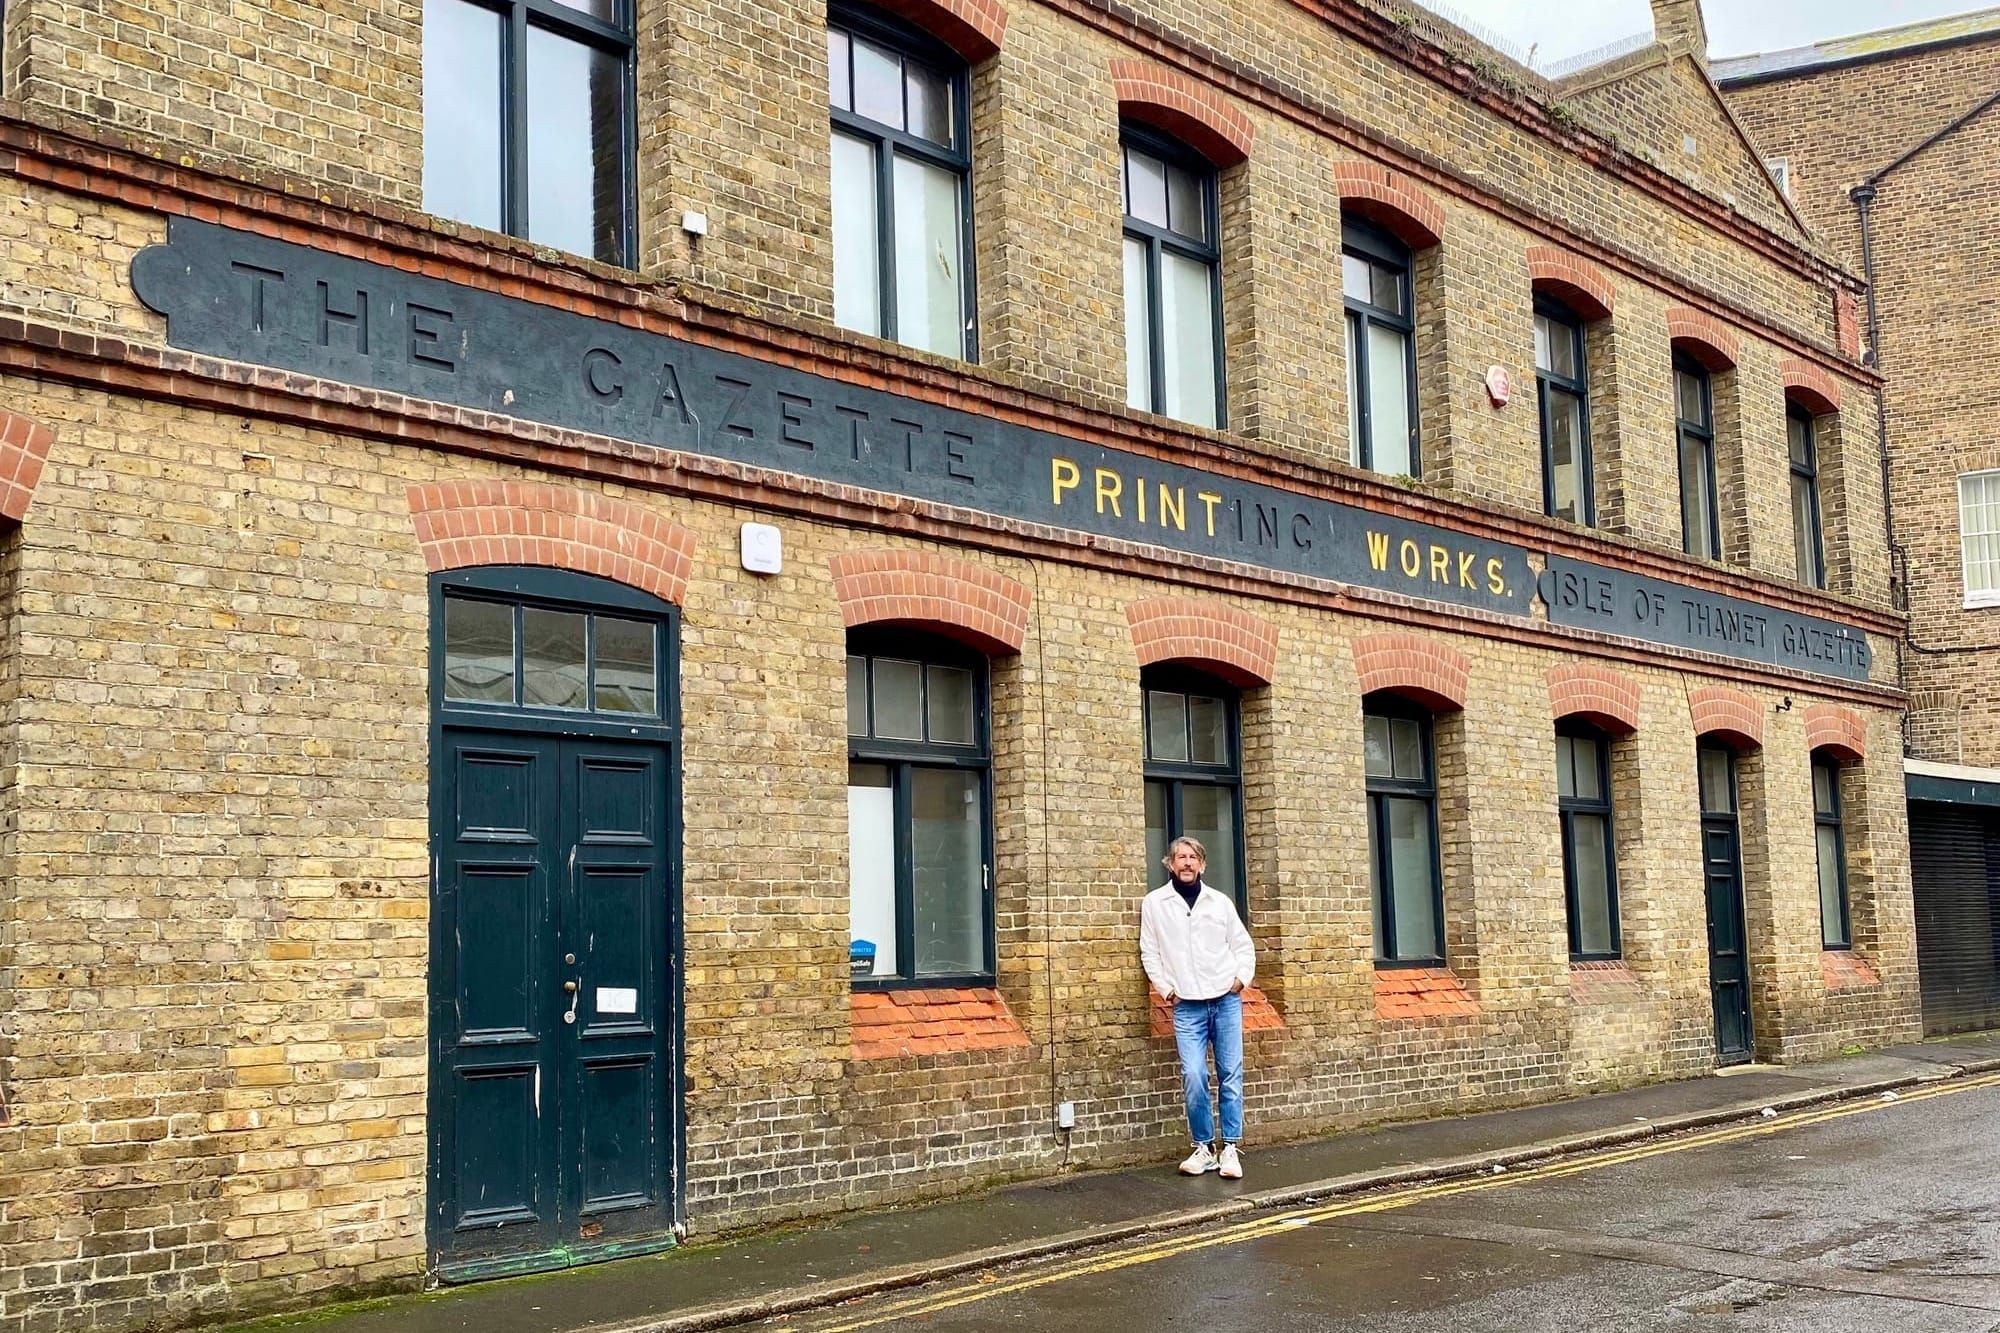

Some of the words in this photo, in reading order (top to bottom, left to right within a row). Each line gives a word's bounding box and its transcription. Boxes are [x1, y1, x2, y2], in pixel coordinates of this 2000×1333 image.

[230, 260, 455, 373] THE
[581, 346, 975, 486] GAZETTE
[1050, 456, 1313, 551] PRINTING
[1365, 529, 1513, 598] WORKS.
[1551, 569, 1614, 617] ISLE
[1633, 588, 1666, 627] OF
[1682, 600, 1767, 649] THANET
[1782, 622, 1867, 670] GAZETTE
